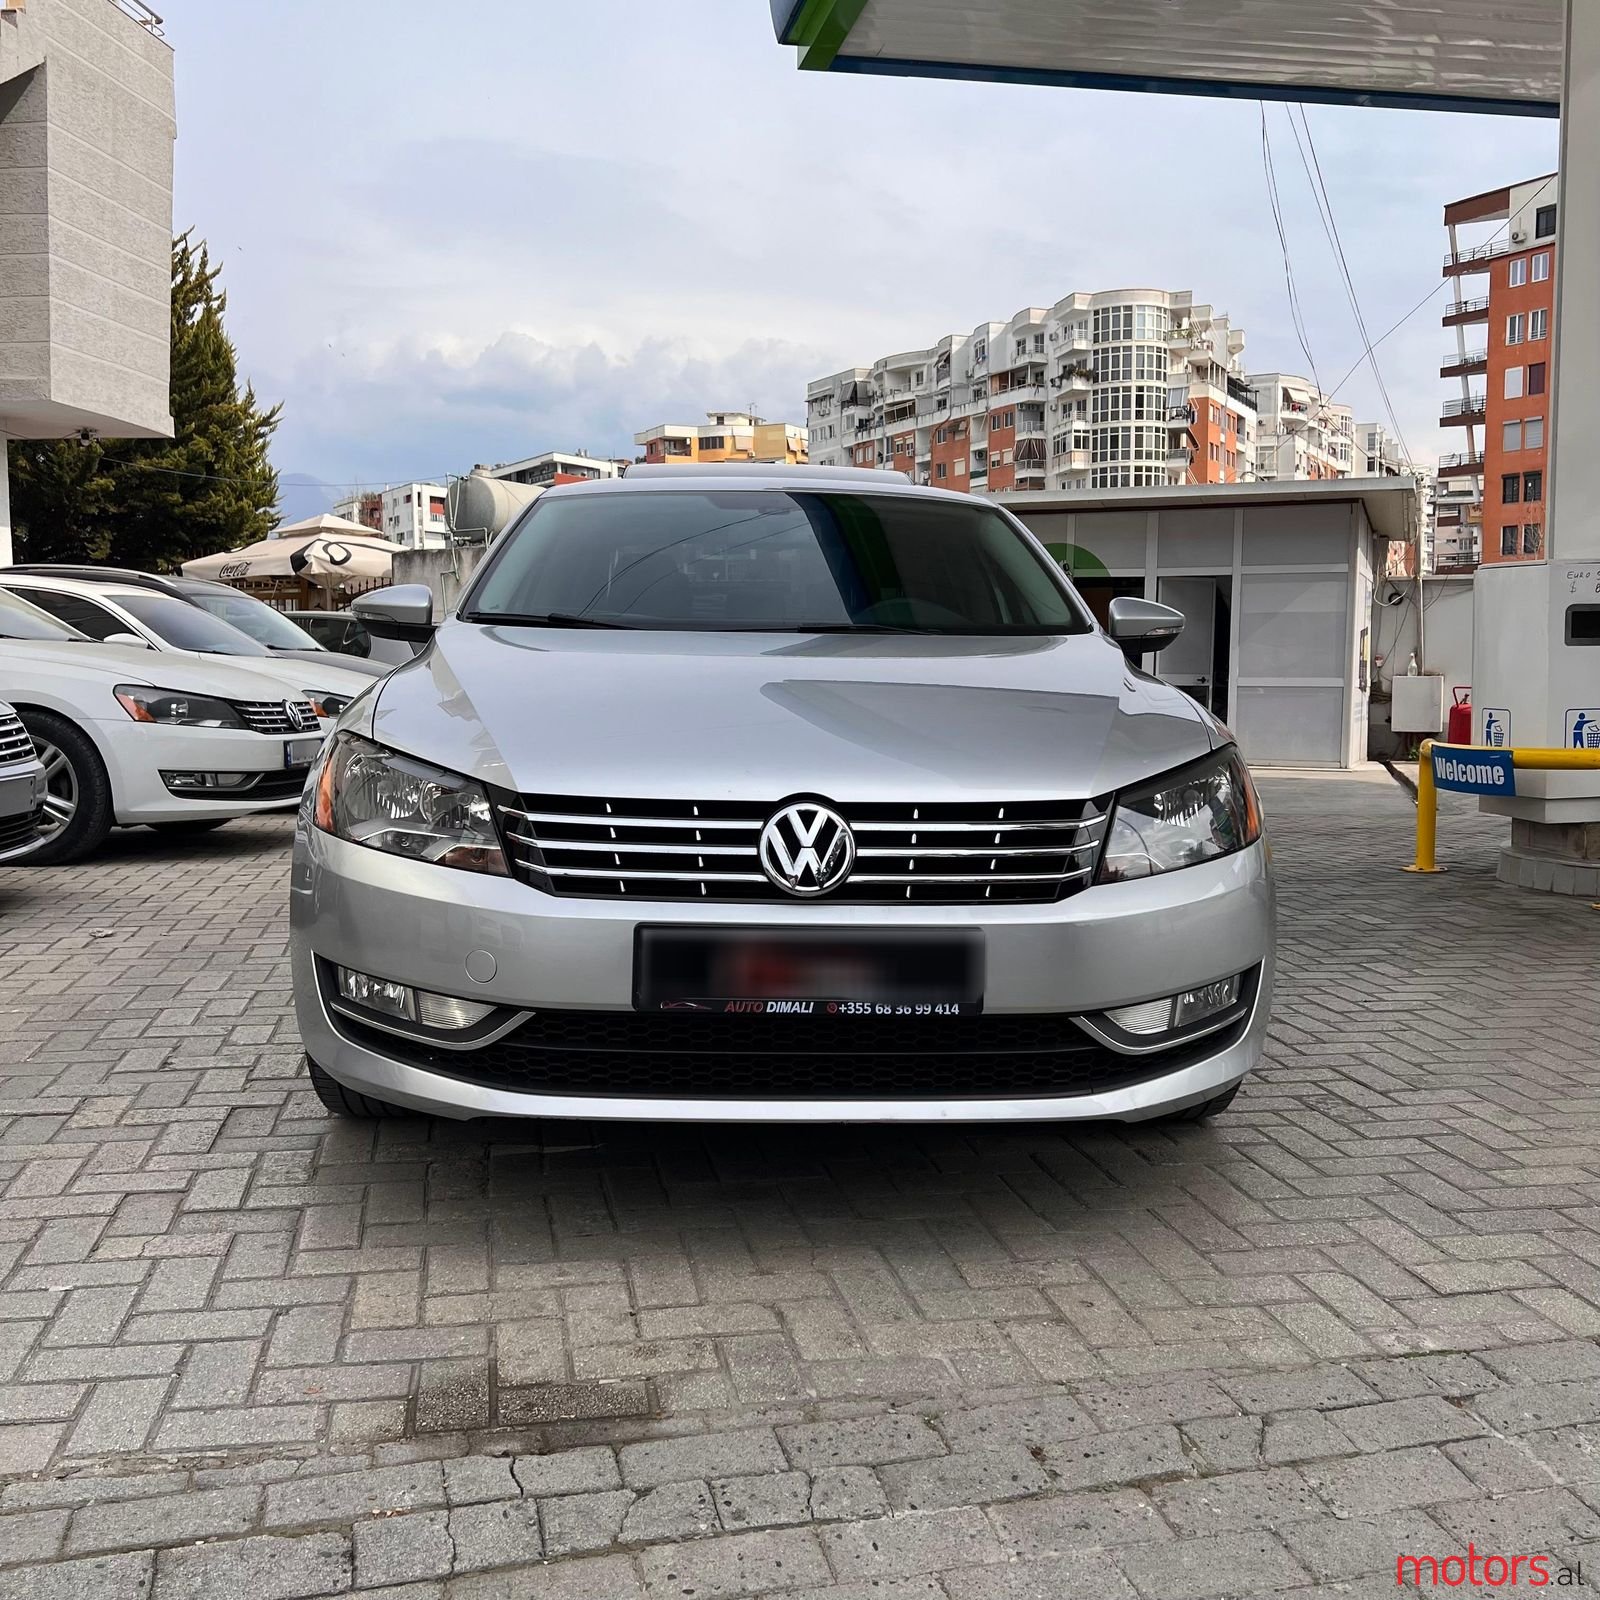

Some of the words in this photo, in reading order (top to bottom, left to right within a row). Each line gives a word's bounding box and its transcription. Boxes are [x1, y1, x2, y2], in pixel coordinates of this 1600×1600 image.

[1435, 756, 1504, 785] Welcome
[724, 1001, 764, 1013] AUTO
[766, 1001, 815, 1014] DIMALI
[838, 1002, 872, 1015] +355
[875, 1003, 892, 1015] 68
[915, 1003, 932, 1015] 99
[934, 1003, 960, 1015] 414
